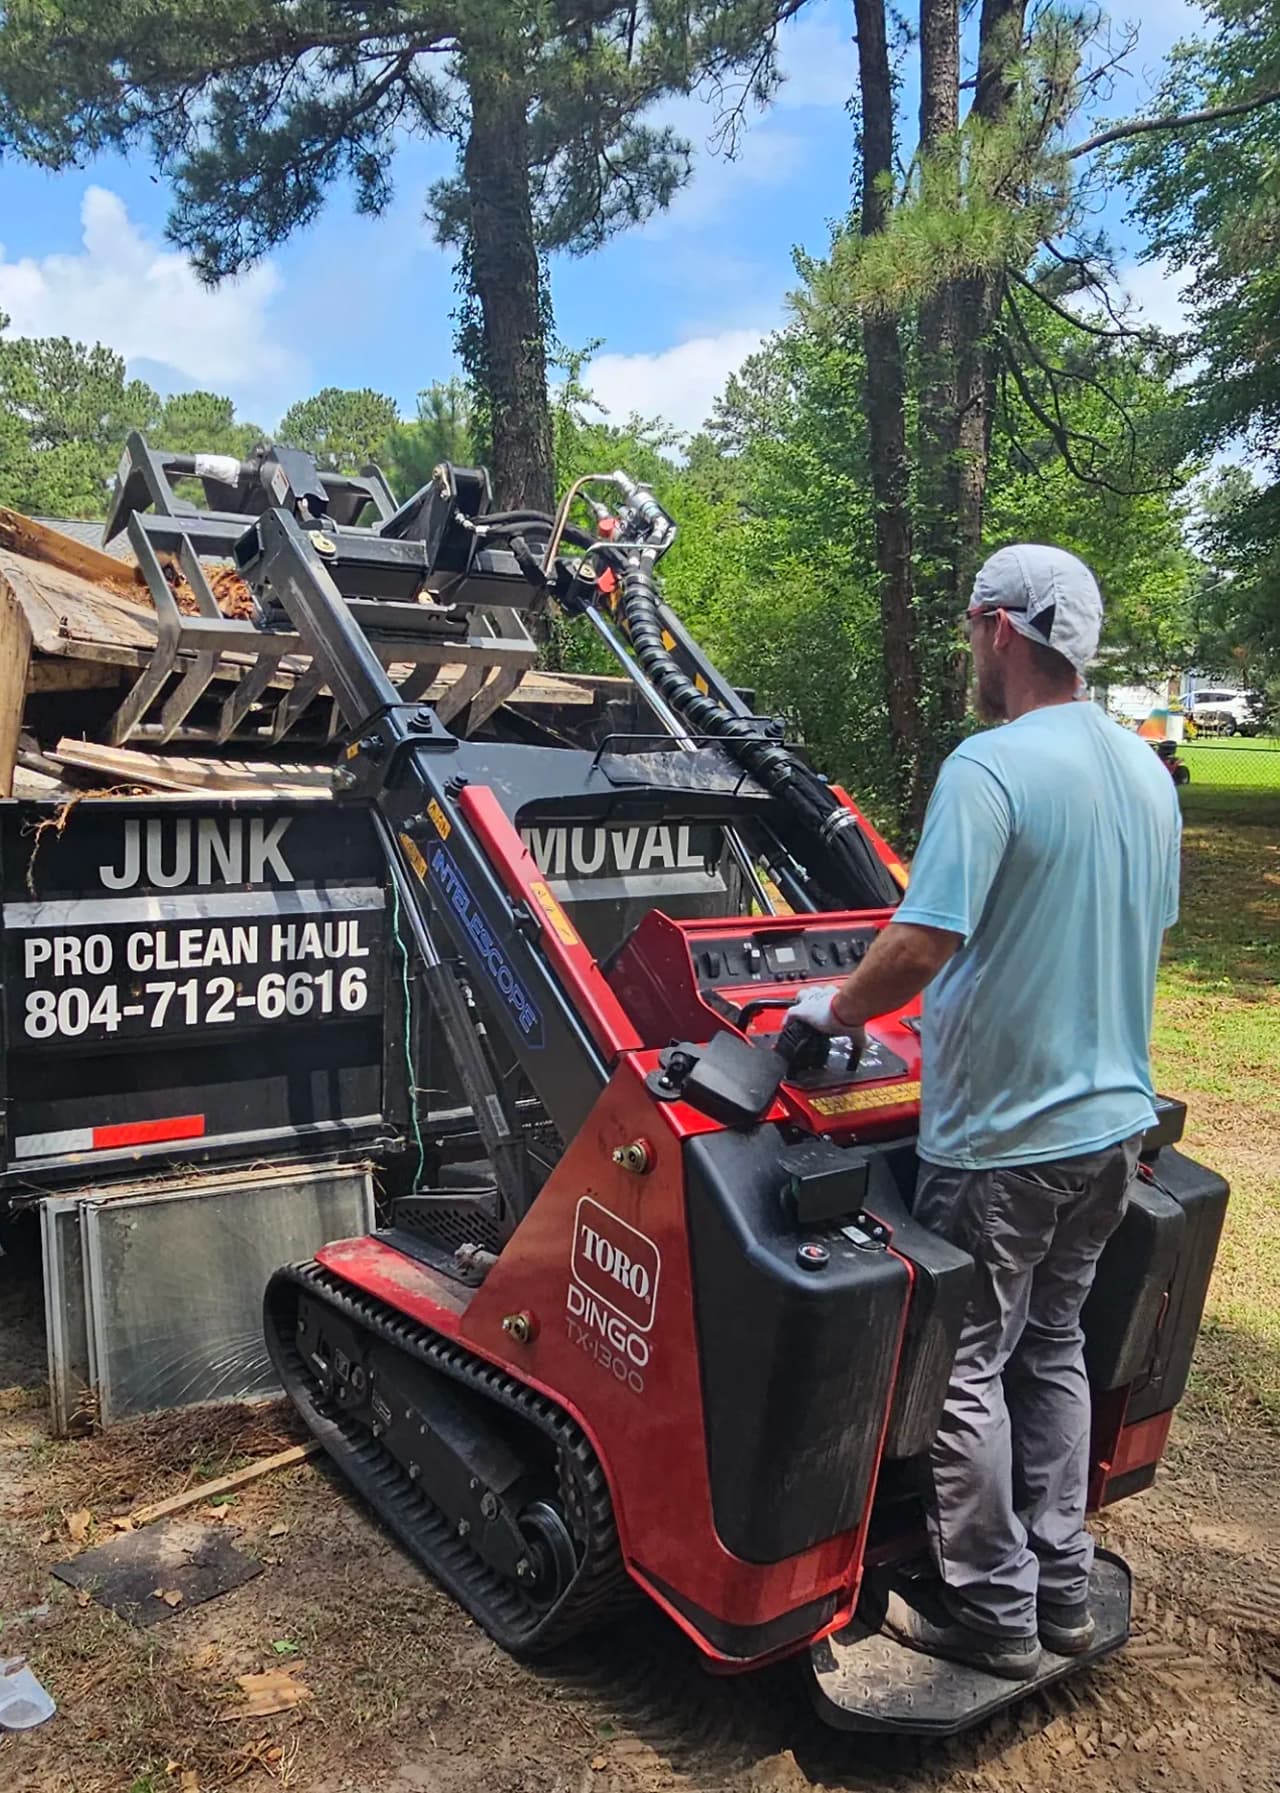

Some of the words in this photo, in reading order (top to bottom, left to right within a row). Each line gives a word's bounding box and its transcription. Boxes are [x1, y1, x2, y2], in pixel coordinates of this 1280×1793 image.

[100, 817, 295, 889] JUNK
[24, 935, 113, 978] PRO
[127, 927, 258, 972] CLEAN
[271, 920, 369, 961] HAUL
[24, 967, 368, 1038] 804-712-6616
[581, 1224, 650, 1299] TORO
[566, 1283, 650, 1367] DINGO
